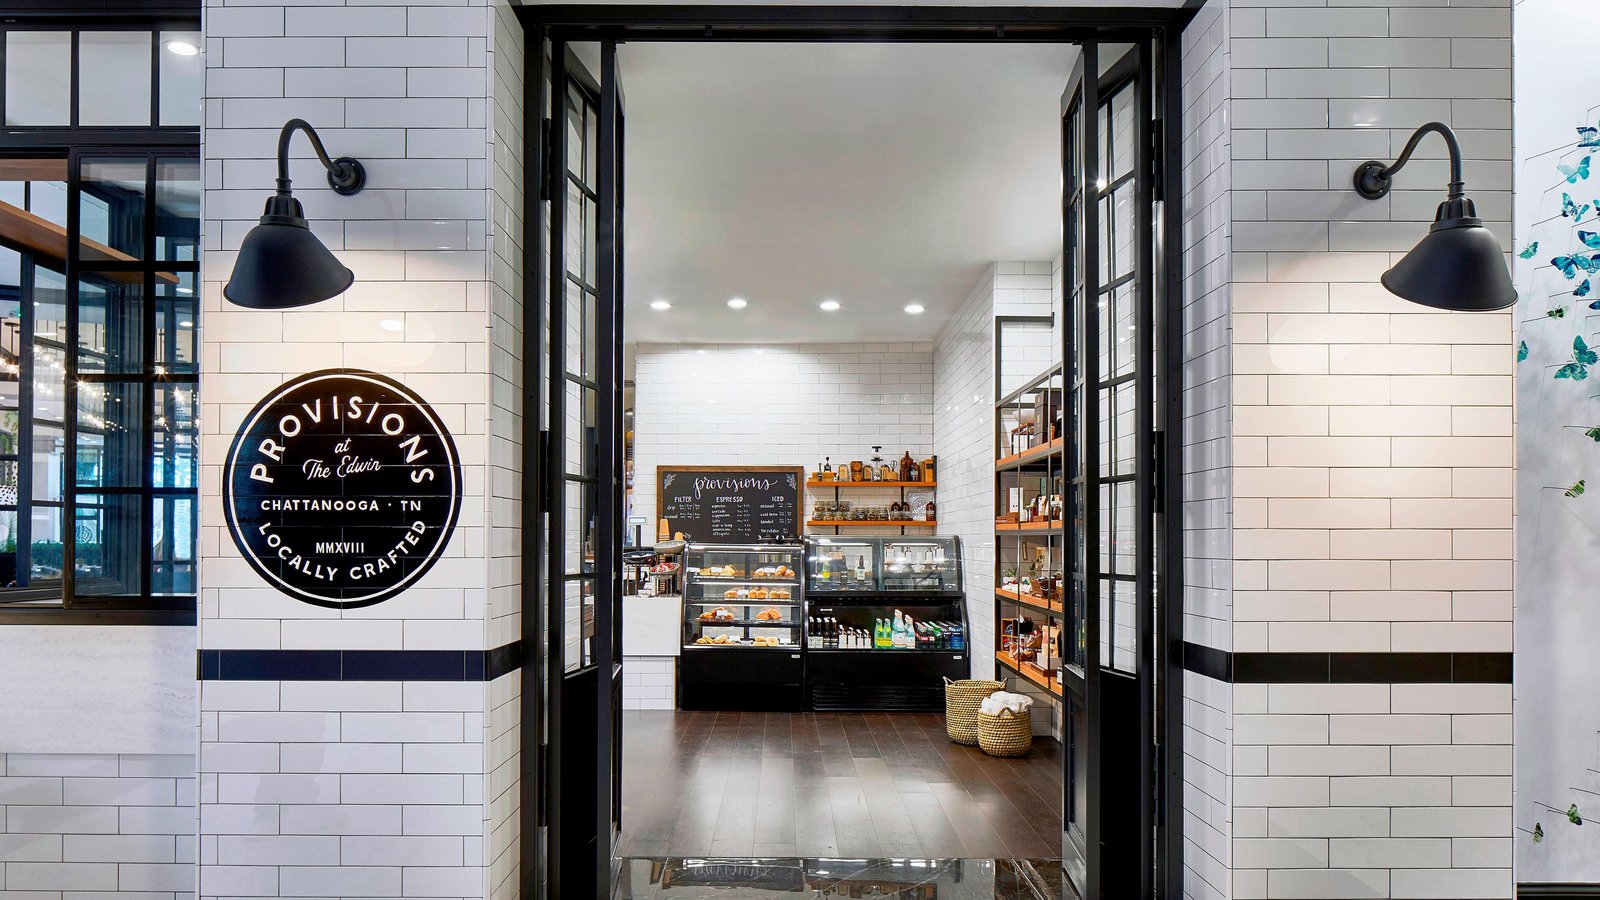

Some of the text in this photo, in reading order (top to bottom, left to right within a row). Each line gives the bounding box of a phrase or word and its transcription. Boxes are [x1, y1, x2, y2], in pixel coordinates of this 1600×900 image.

[250, 395, 434, 483] PROVISIONS
[334, 437, 352, 454] at
[302, 455, 382, 481] The Edwin
[693, 476, 778, 500] provisions
[260, 499, 422, 511] CHATTANOOGA TN
[258, 520, 426, 581] LOCALLY CRAFTED
[315, 542, 365, 554] MMXVIII
